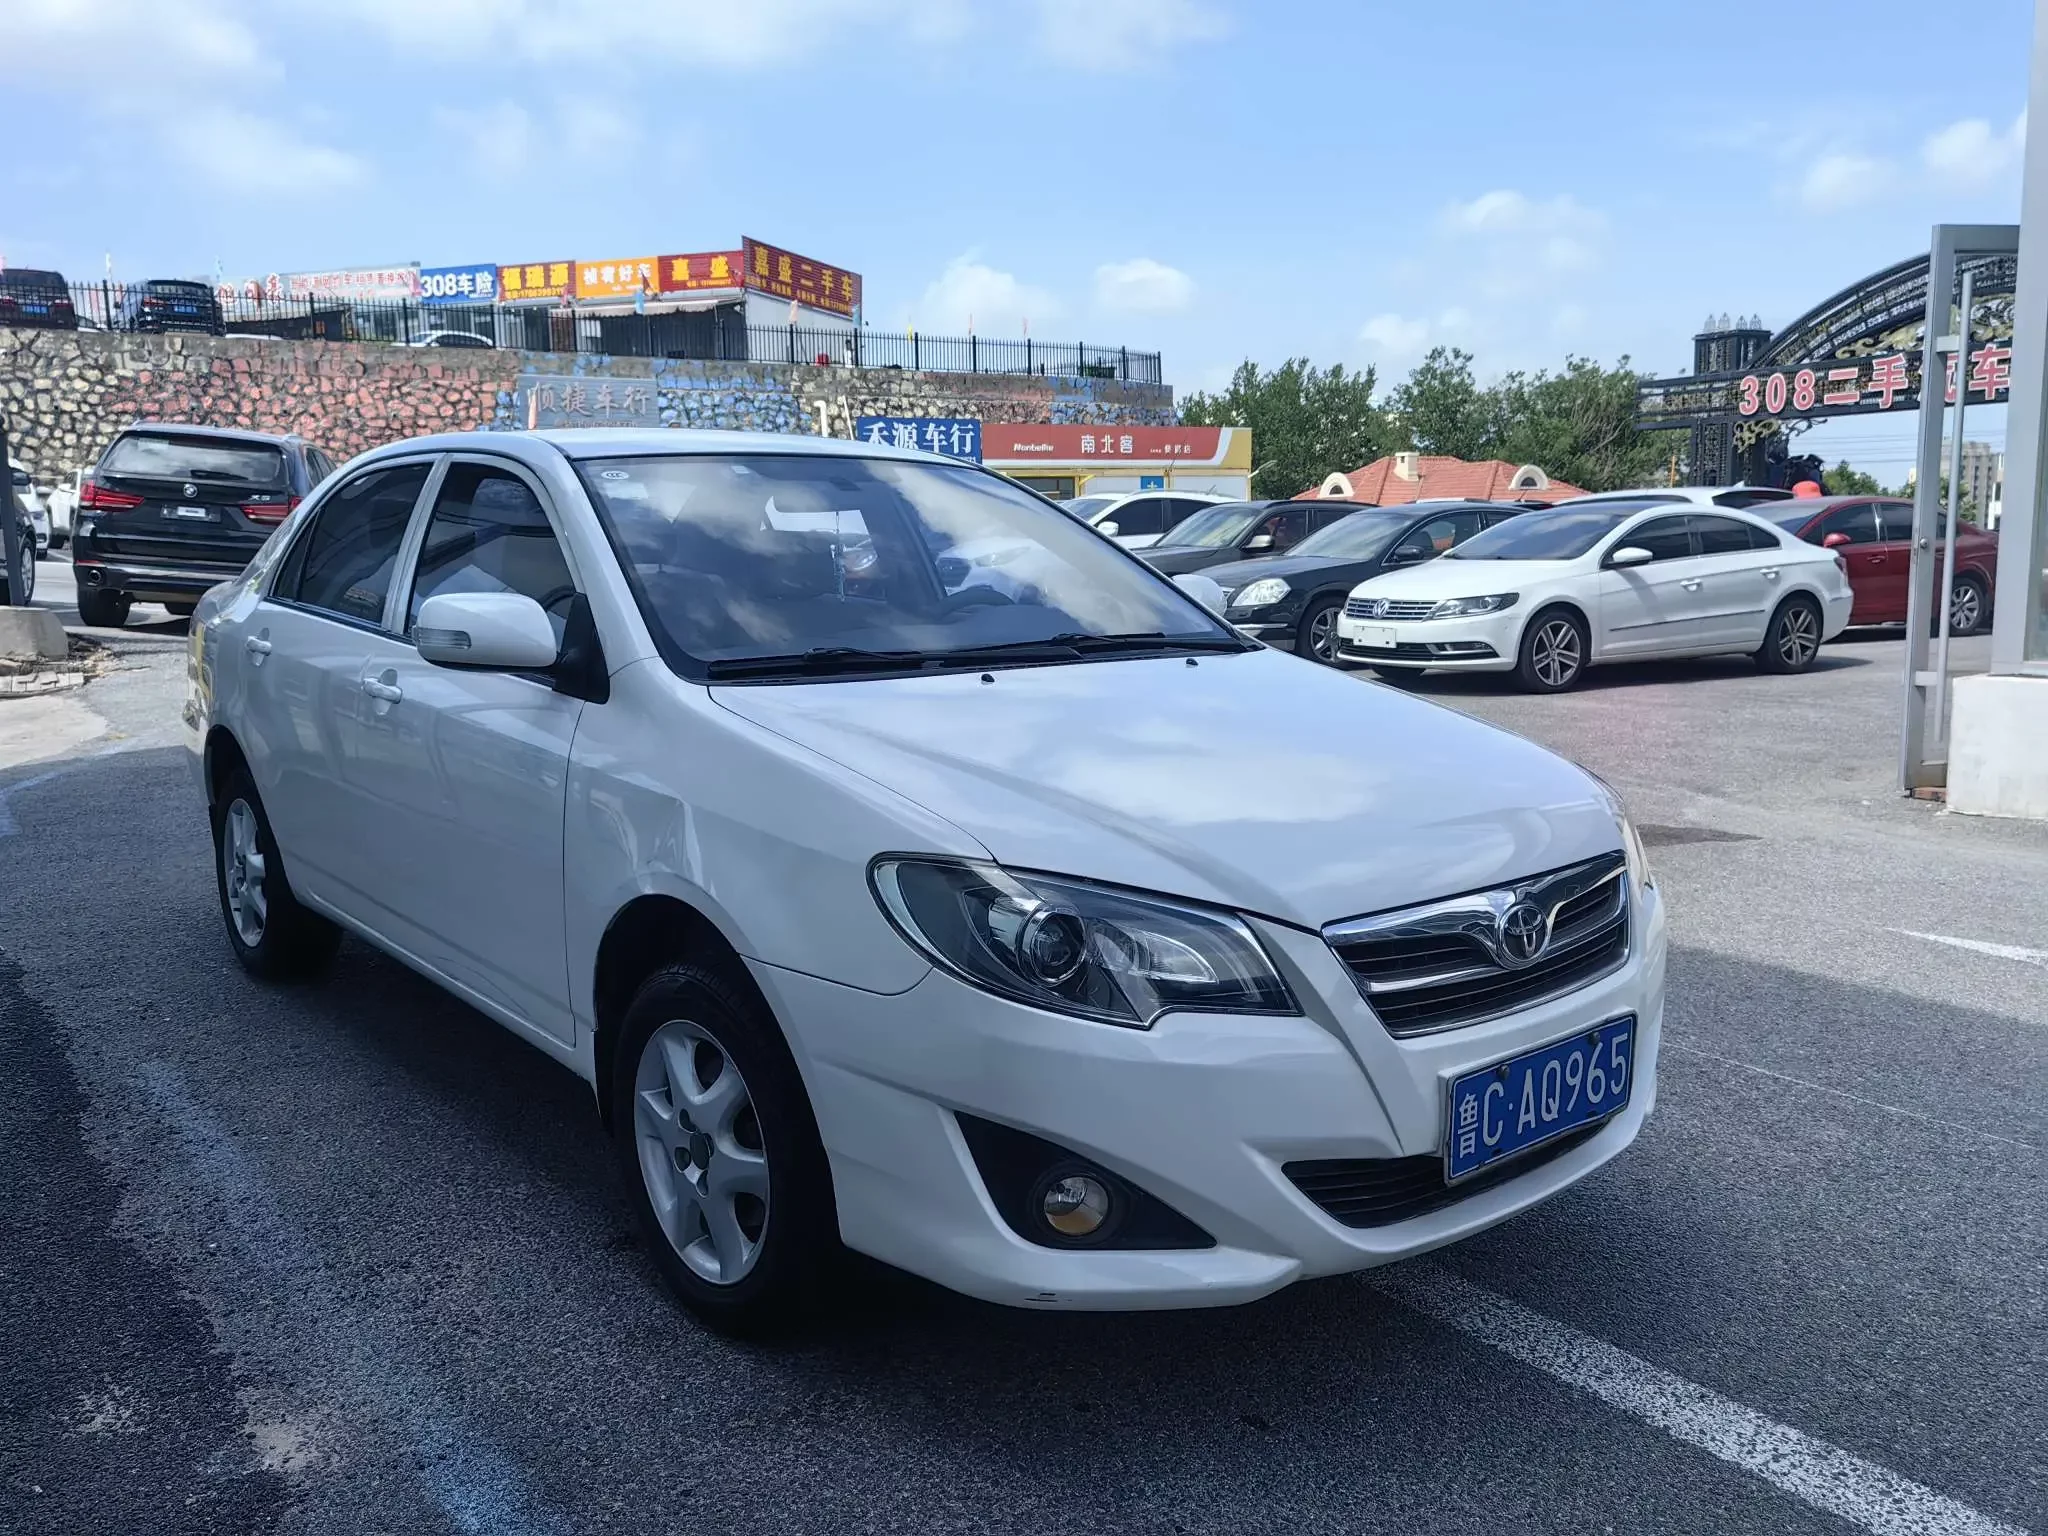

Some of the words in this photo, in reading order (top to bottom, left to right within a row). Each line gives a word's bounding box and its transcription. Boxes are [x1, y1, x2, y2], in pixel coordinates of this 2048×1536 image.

[420, 271, 493, 297] 308车险
[863, 421, 976, 454] 禾源车行
[1081, 434, 1134, 454] 南北客
